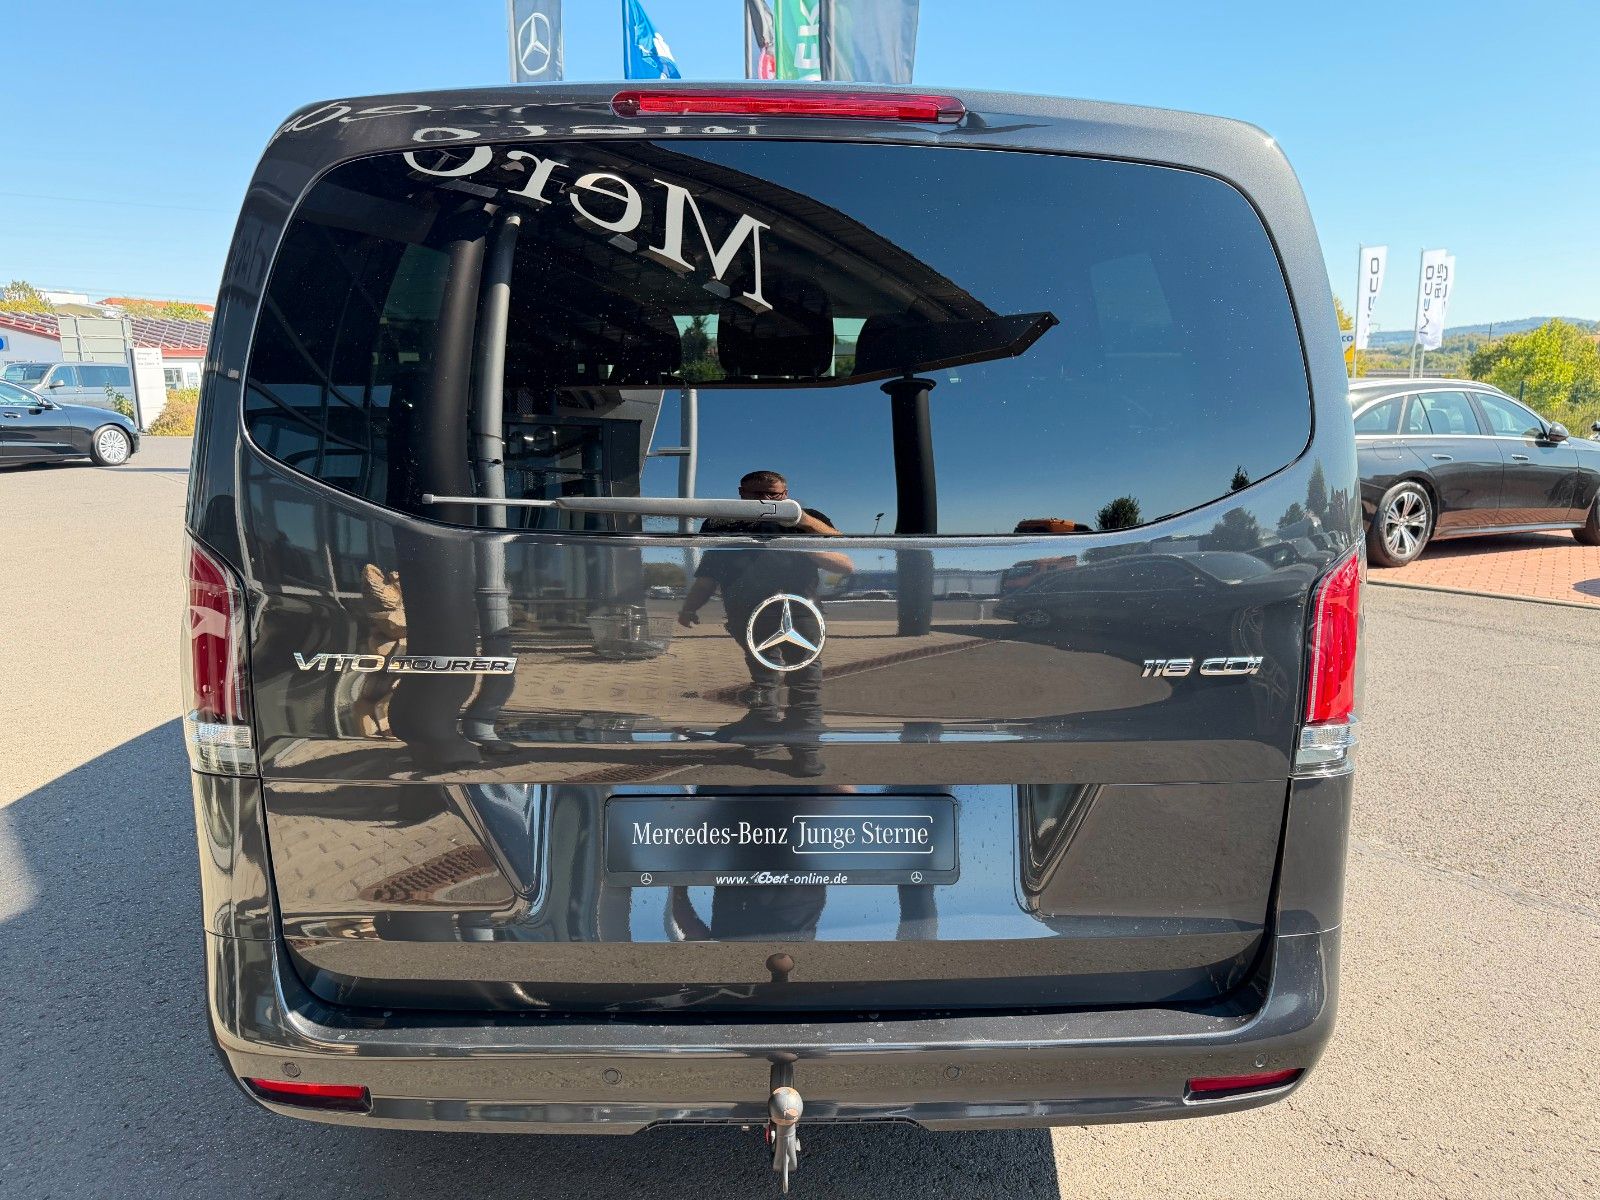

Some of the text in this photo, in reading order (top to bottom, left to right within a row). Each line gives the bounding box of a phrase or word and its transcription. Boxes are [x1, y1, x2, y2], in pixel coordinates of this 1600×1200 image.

[294, 652, 511, 673] VITO TOURER
[1141, 658, 1194, 678] 116
[632, 822, 929, 849] Mercedes-Benz Junge Sterne
